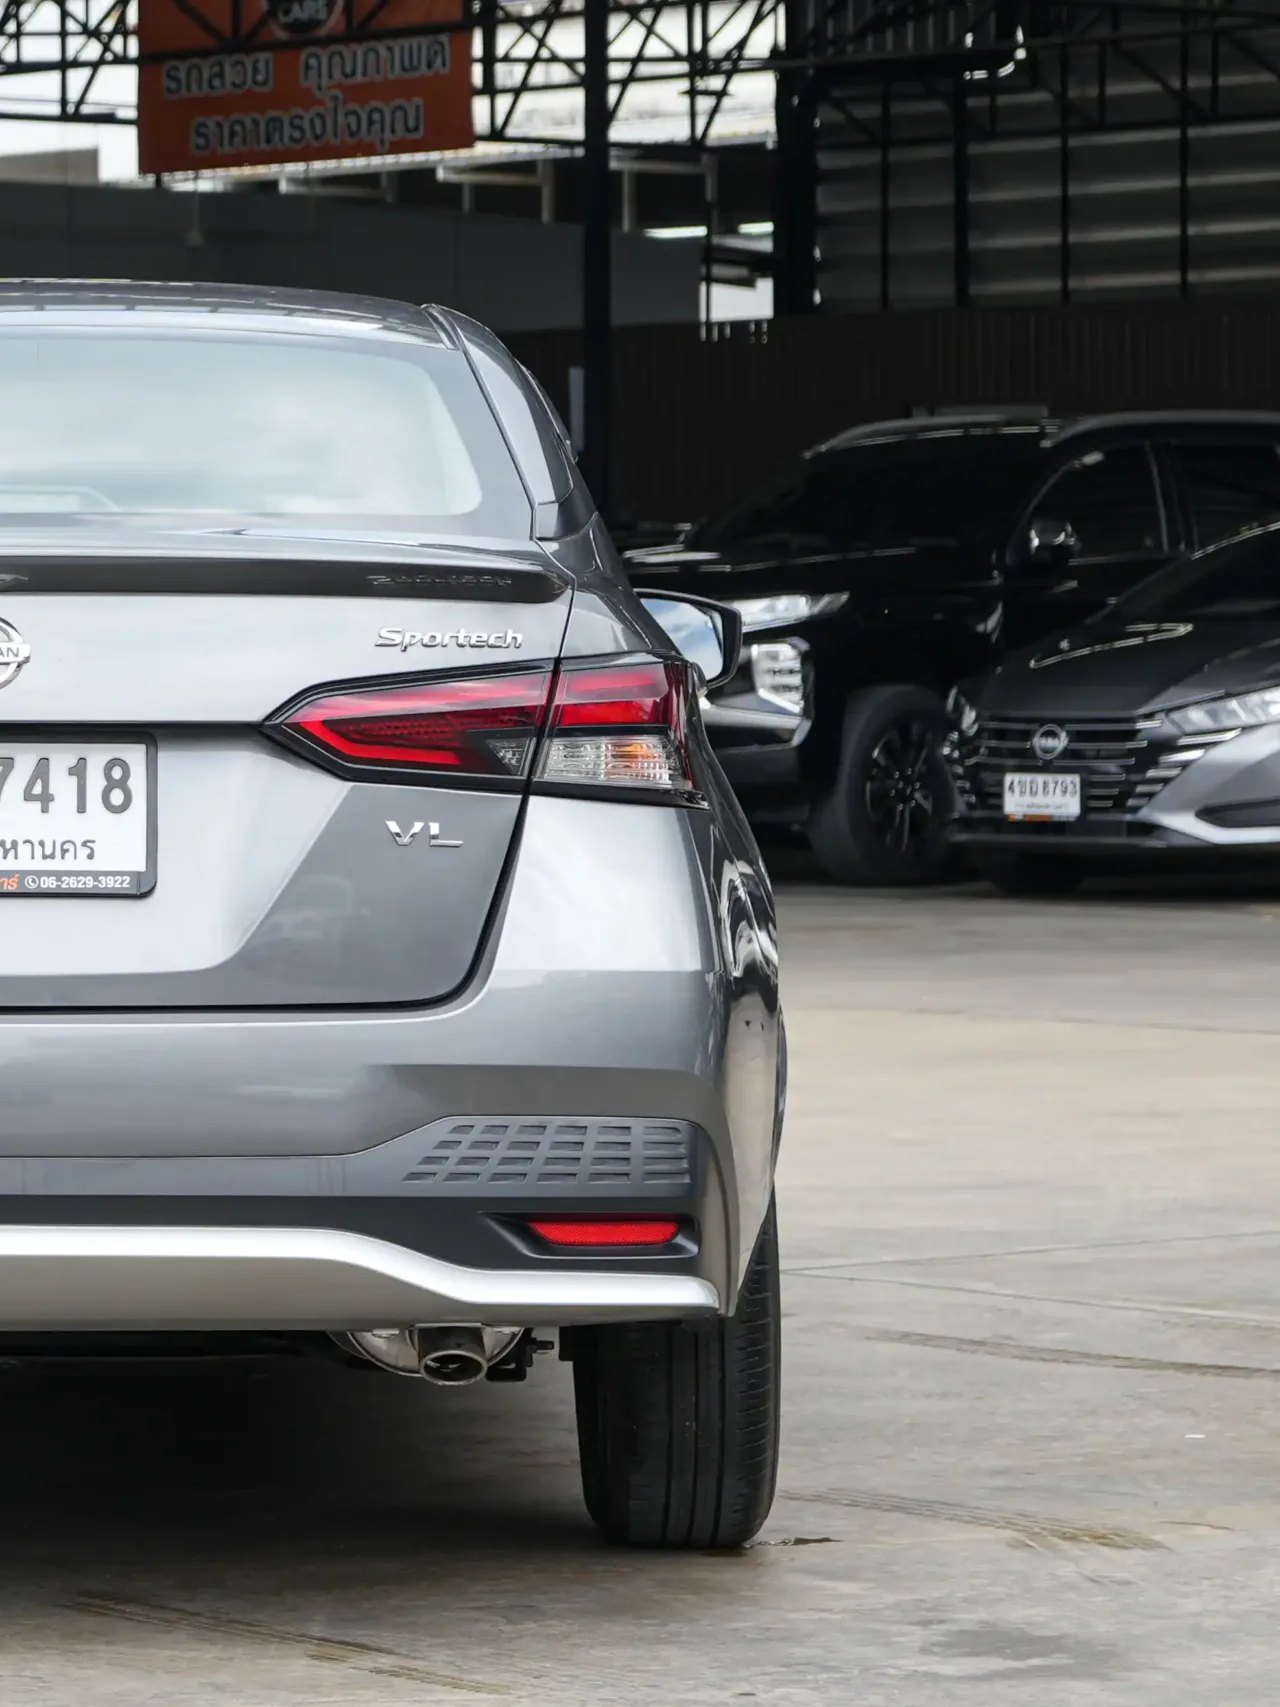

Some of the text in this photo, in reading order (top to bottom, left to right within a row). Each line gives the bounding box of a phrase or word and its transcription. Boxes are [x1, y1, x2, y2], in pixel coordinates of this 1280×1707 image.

[302, 36, 452, 94] คุณภาพด
[374, 626, 524, 651] Sportech
[385, 820, 464, 848] VL
[40, 875, 131, 889] 06-2629-3922
